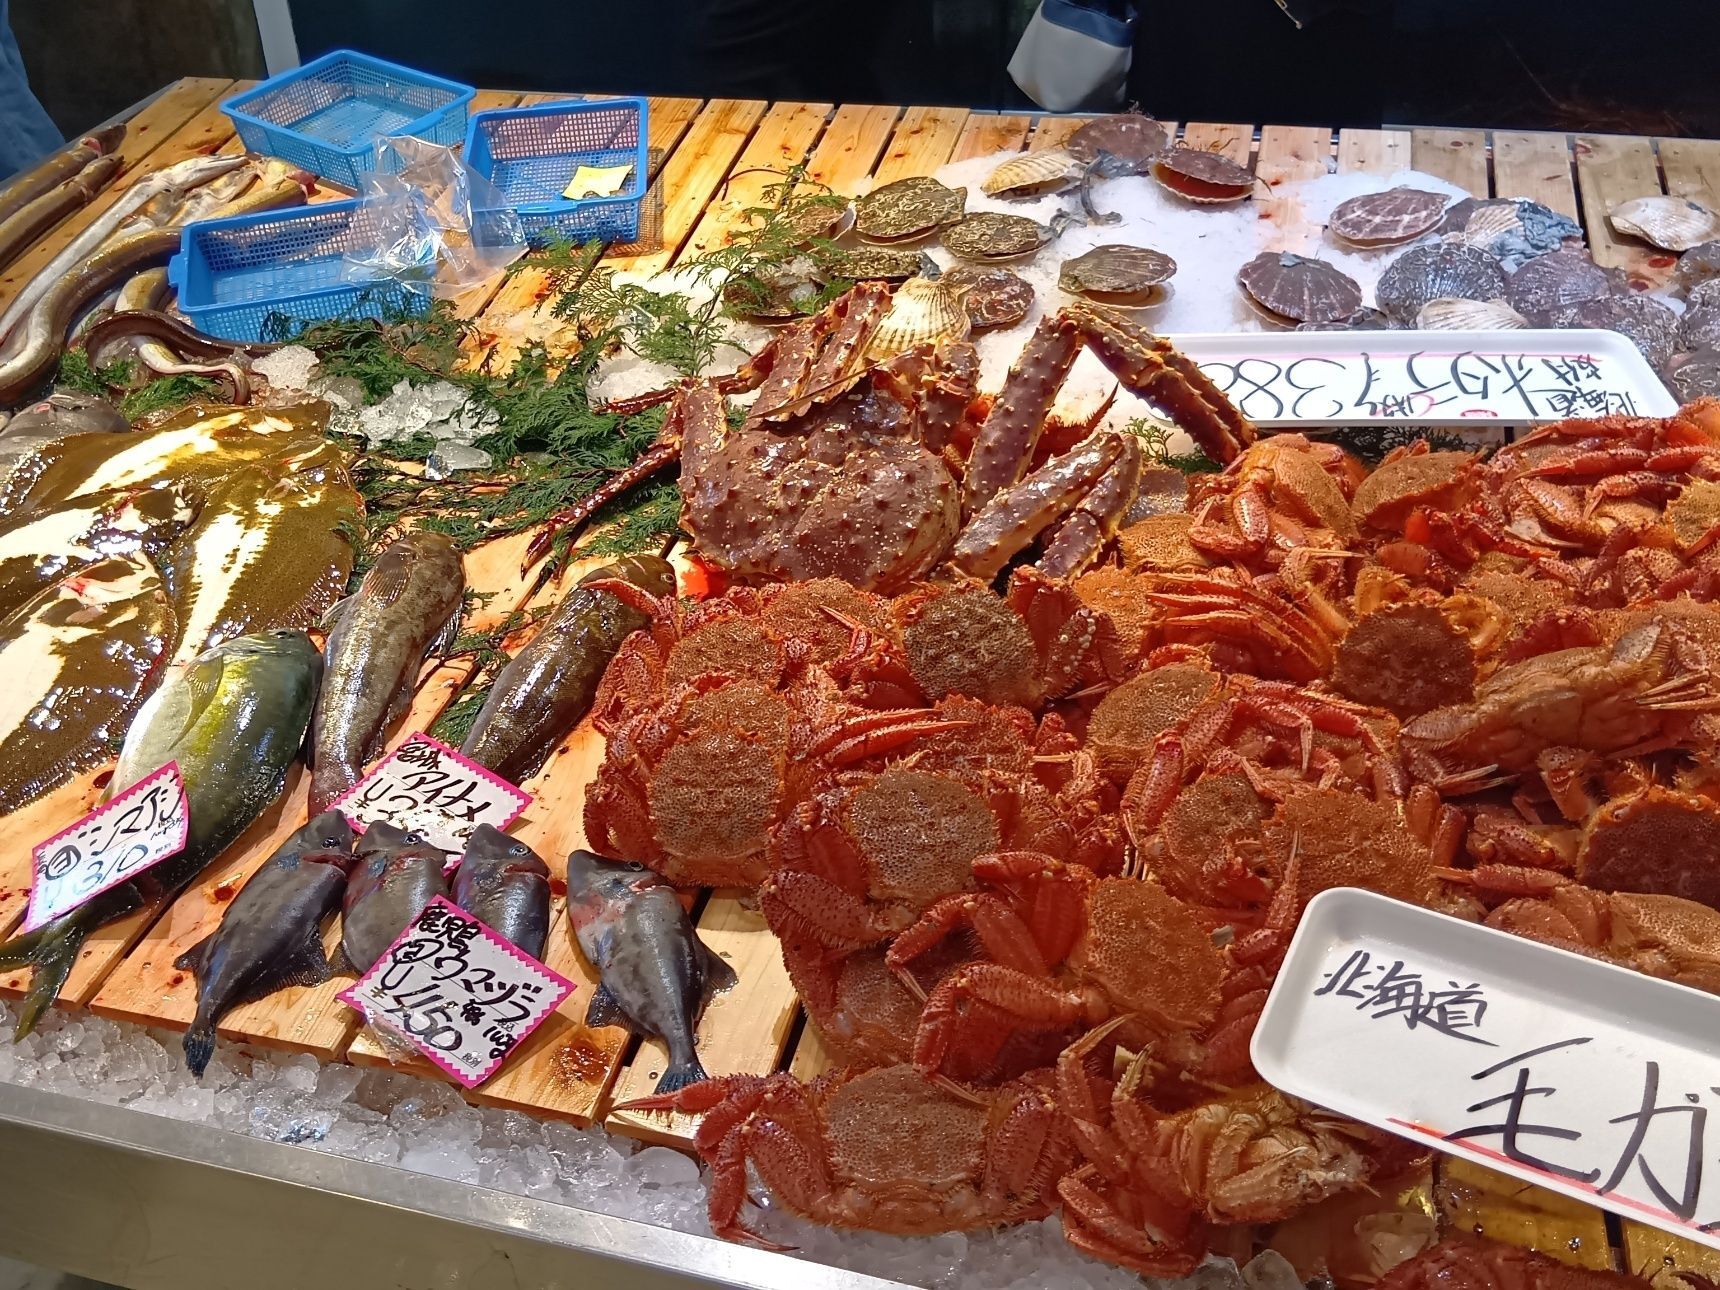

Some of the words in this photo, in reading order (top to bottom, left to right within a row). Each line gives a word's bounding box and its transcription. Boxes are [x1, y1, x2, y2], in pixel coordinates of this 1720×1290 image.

[402, 771, 492, 822] アイナメ
[1314, 949, 1500, 1047] 北海道
[1442, 1037, 1720, 1232] 毛ガ
